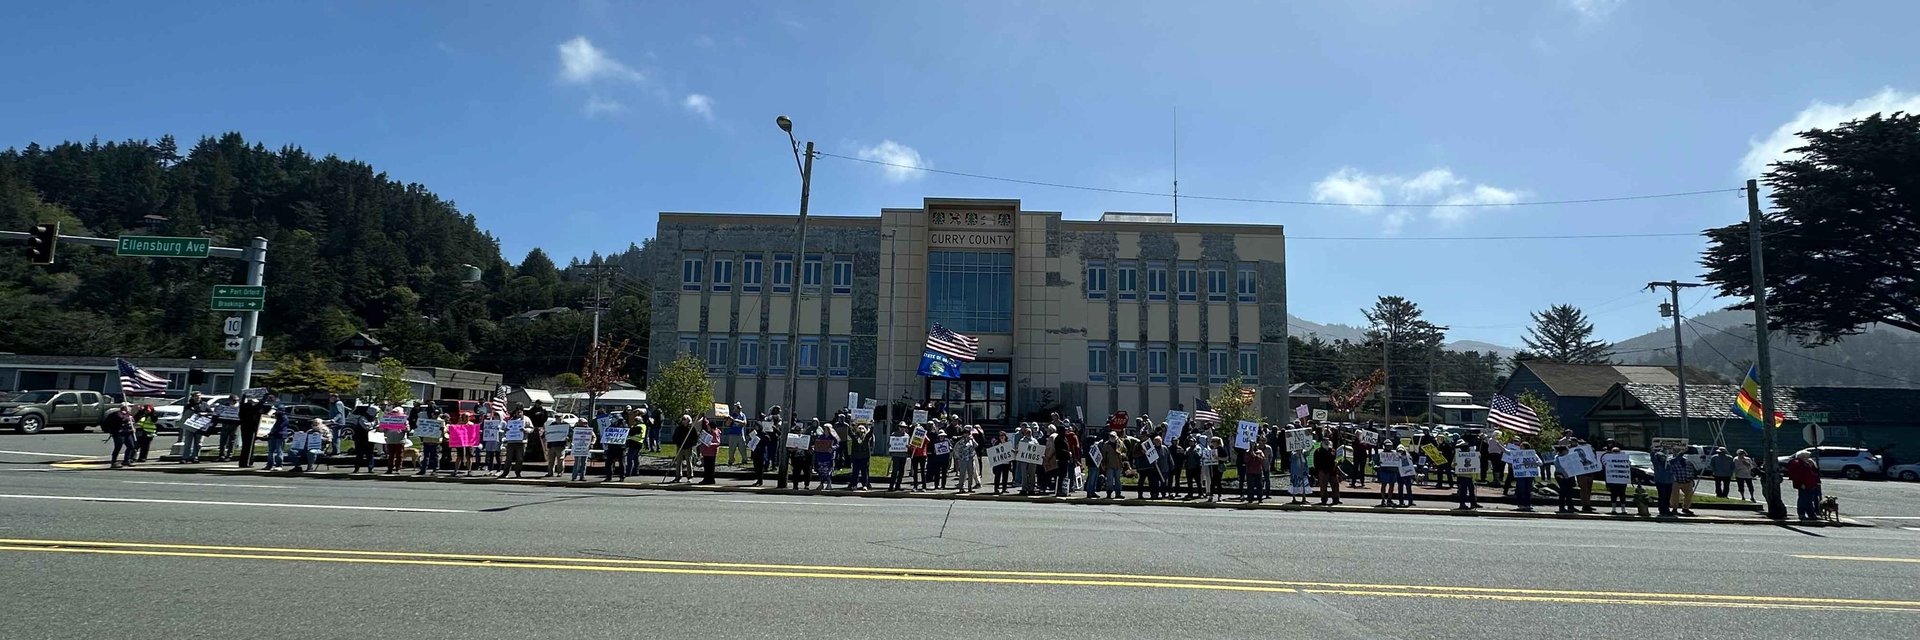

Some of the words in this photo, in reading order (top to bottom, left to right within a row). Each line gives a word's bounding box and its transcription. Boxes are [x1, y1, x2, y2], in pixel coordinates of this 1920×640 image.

[931, 234, 966, 244] CURRY
[968, 235, 1011, 245] COUNTY
[121, 238, 181, 254] Ellensburg
[186, 241, 206, 252] Ave
[995, 446, 1004, 454] NO
[1027, 444, 1037, 452] NO
[992, 451, 1012, 463] KINGS
[1020, 452, 1040, 461] KINGS
